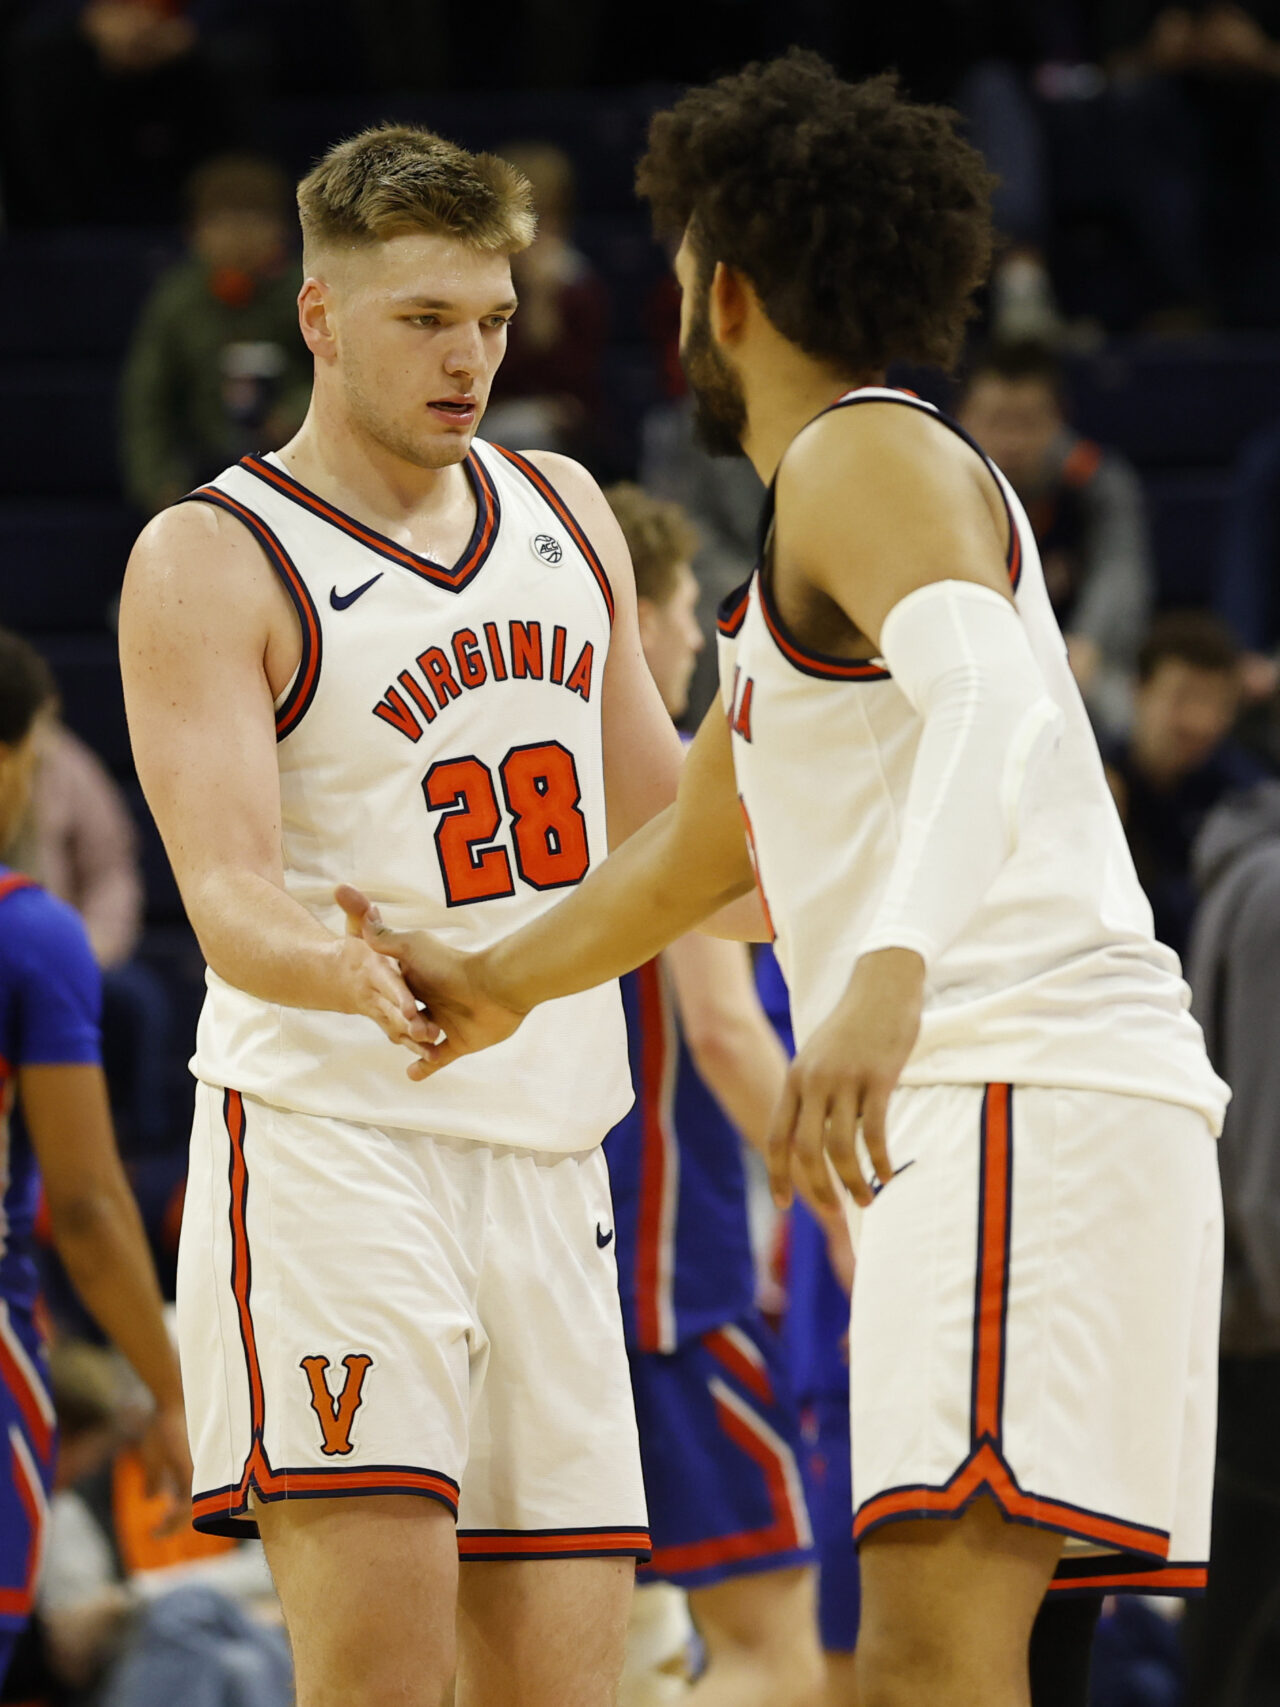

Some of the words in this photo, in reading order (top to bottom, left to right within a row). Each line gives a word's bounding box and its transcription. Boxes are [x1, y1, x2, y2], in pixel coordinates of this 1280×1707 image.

[372, 620, 594, 743] VIRGINIA
[421, 739, 590, 908] 28
[299, 1354, 373, 1456] V
